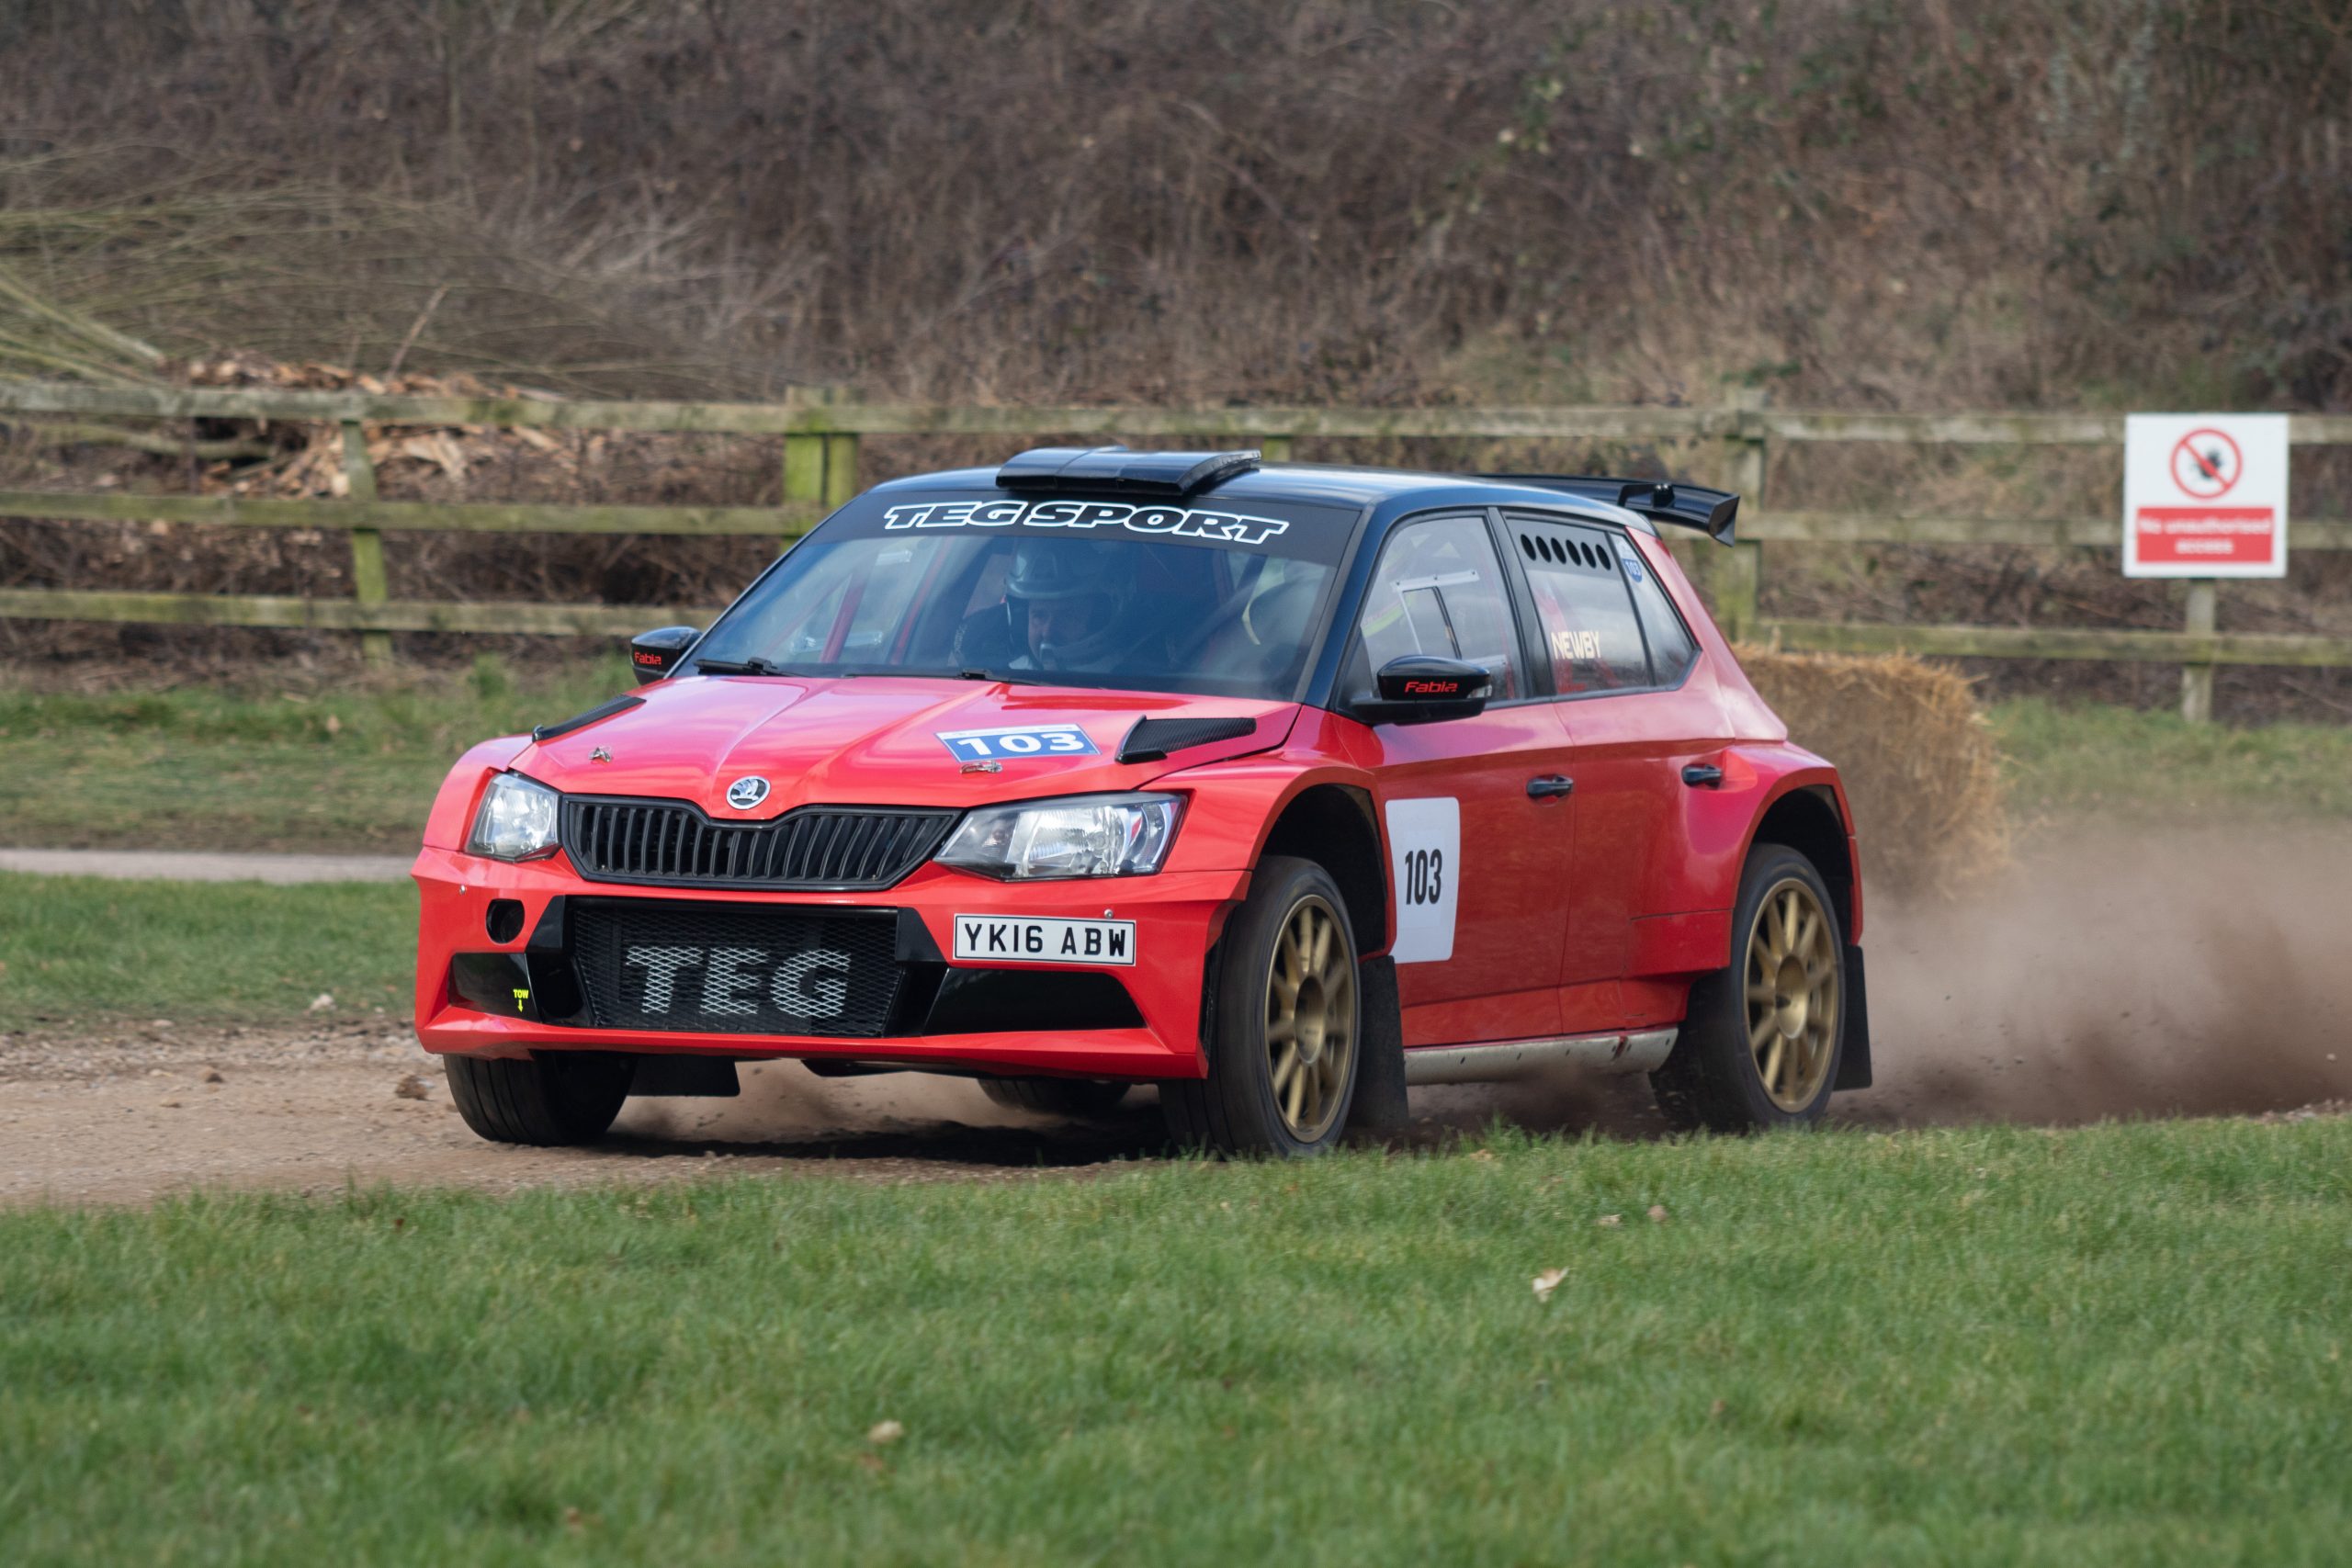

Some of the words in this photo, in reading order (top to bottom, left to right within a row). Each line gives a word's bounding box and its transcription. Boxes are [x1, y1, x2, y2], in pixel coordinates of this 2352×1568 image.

[884, 501, 1027, 530] TEG
[1023, 501, 1290, 544] SPORT
[634, 651, 662, 665] Fabia
[1551, 631, 1600, 660] NEWBY
[1404, 681, 1458, 693] Fabia
[957, 733, 1084, 756] 103
[1405, 848, 1442, 905] 103
[965, 923, 1043, 953] YK16
[1060, 927, 1126, 957] ABW
[513, 988, 529, 999] TOW
[626, 946, 852, 1019] TEG
